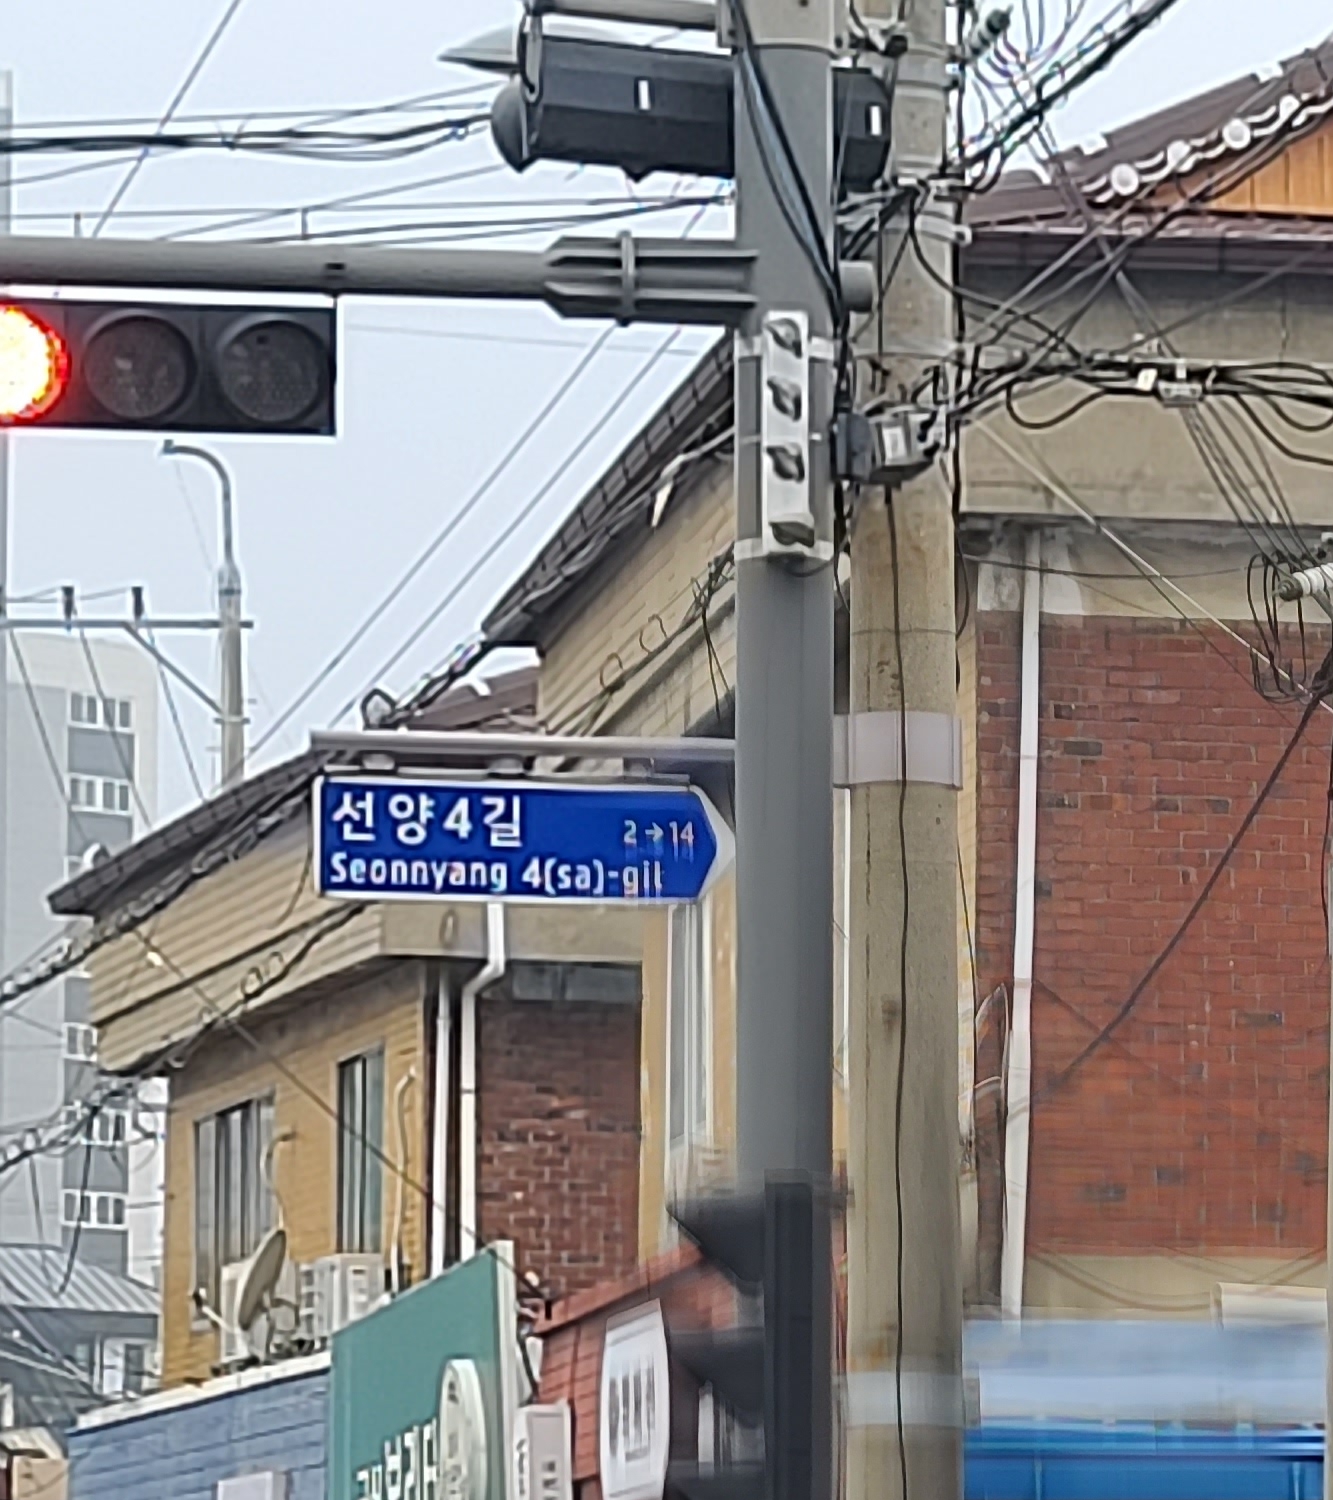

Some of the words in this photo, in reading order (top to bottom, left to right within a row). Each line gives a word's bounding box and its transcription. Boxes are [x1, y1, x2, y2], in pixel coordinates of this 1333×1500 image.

[332, 790, 524, 849] 선양4길
[623, 819, 638, 847] 2
[669, 820, 695, 848] 14
[330, 850, 508, 894] Seonnyang
[521, 856, 664, 899] 4(sa)-gil
